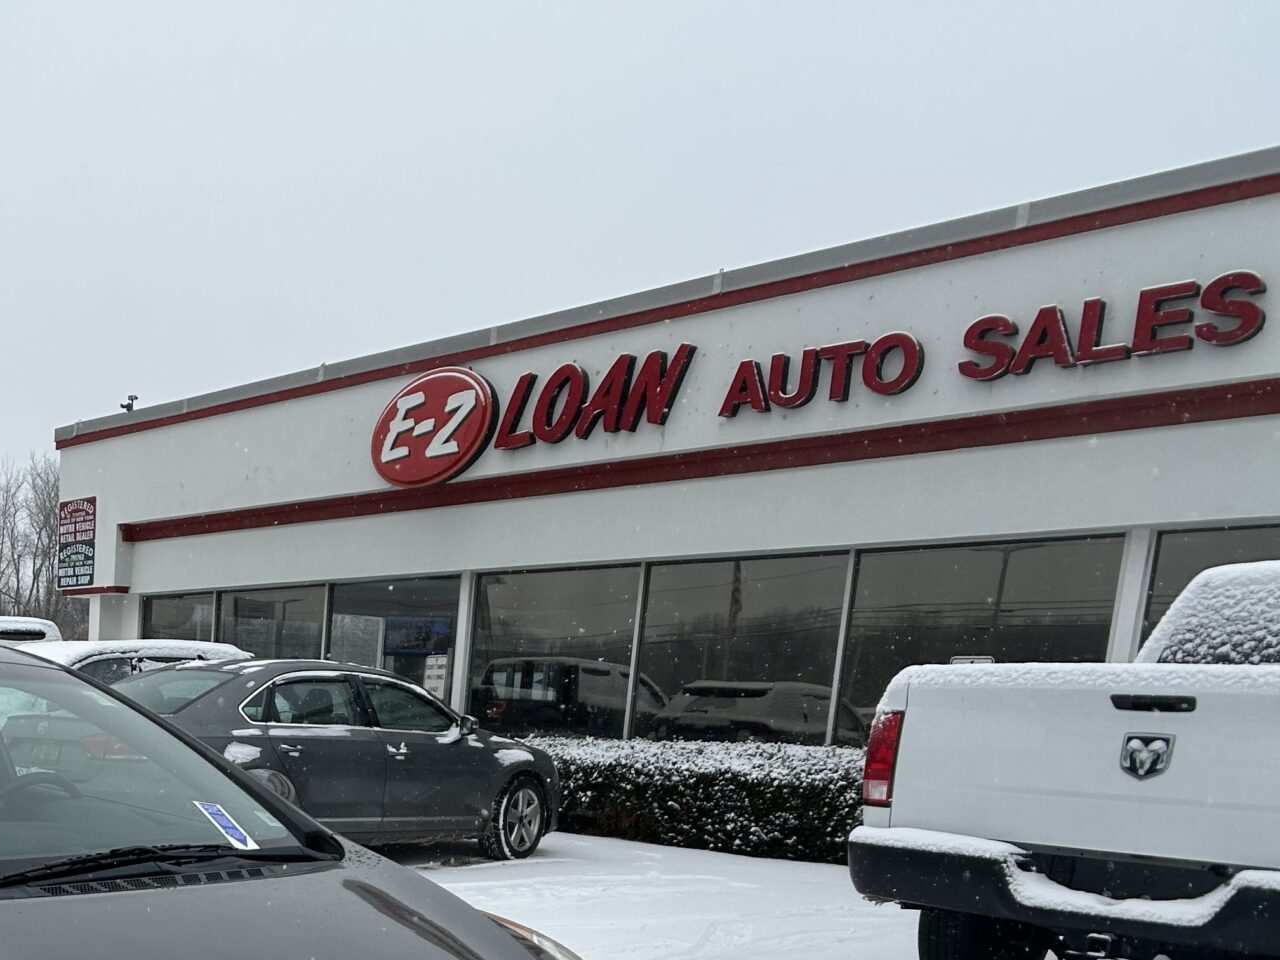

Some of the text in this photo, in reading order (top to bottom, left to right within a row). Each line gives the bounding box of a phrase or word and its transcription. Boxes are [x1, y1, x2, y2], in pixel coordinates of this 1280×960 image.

[381, 269, 1267, 463] E-Z LOAN AUTO SALES
[60, 500, 94, 519] REGISTERED
[76, 520, 95, 531] VEHICLE
[76, 530, 94, 541] DEALER
[60, 544, 94, 560] REGISTERED
[75, 565, 93, 575] VEHICLE
[60, 575, 90, 586] REPAIR SHOP
